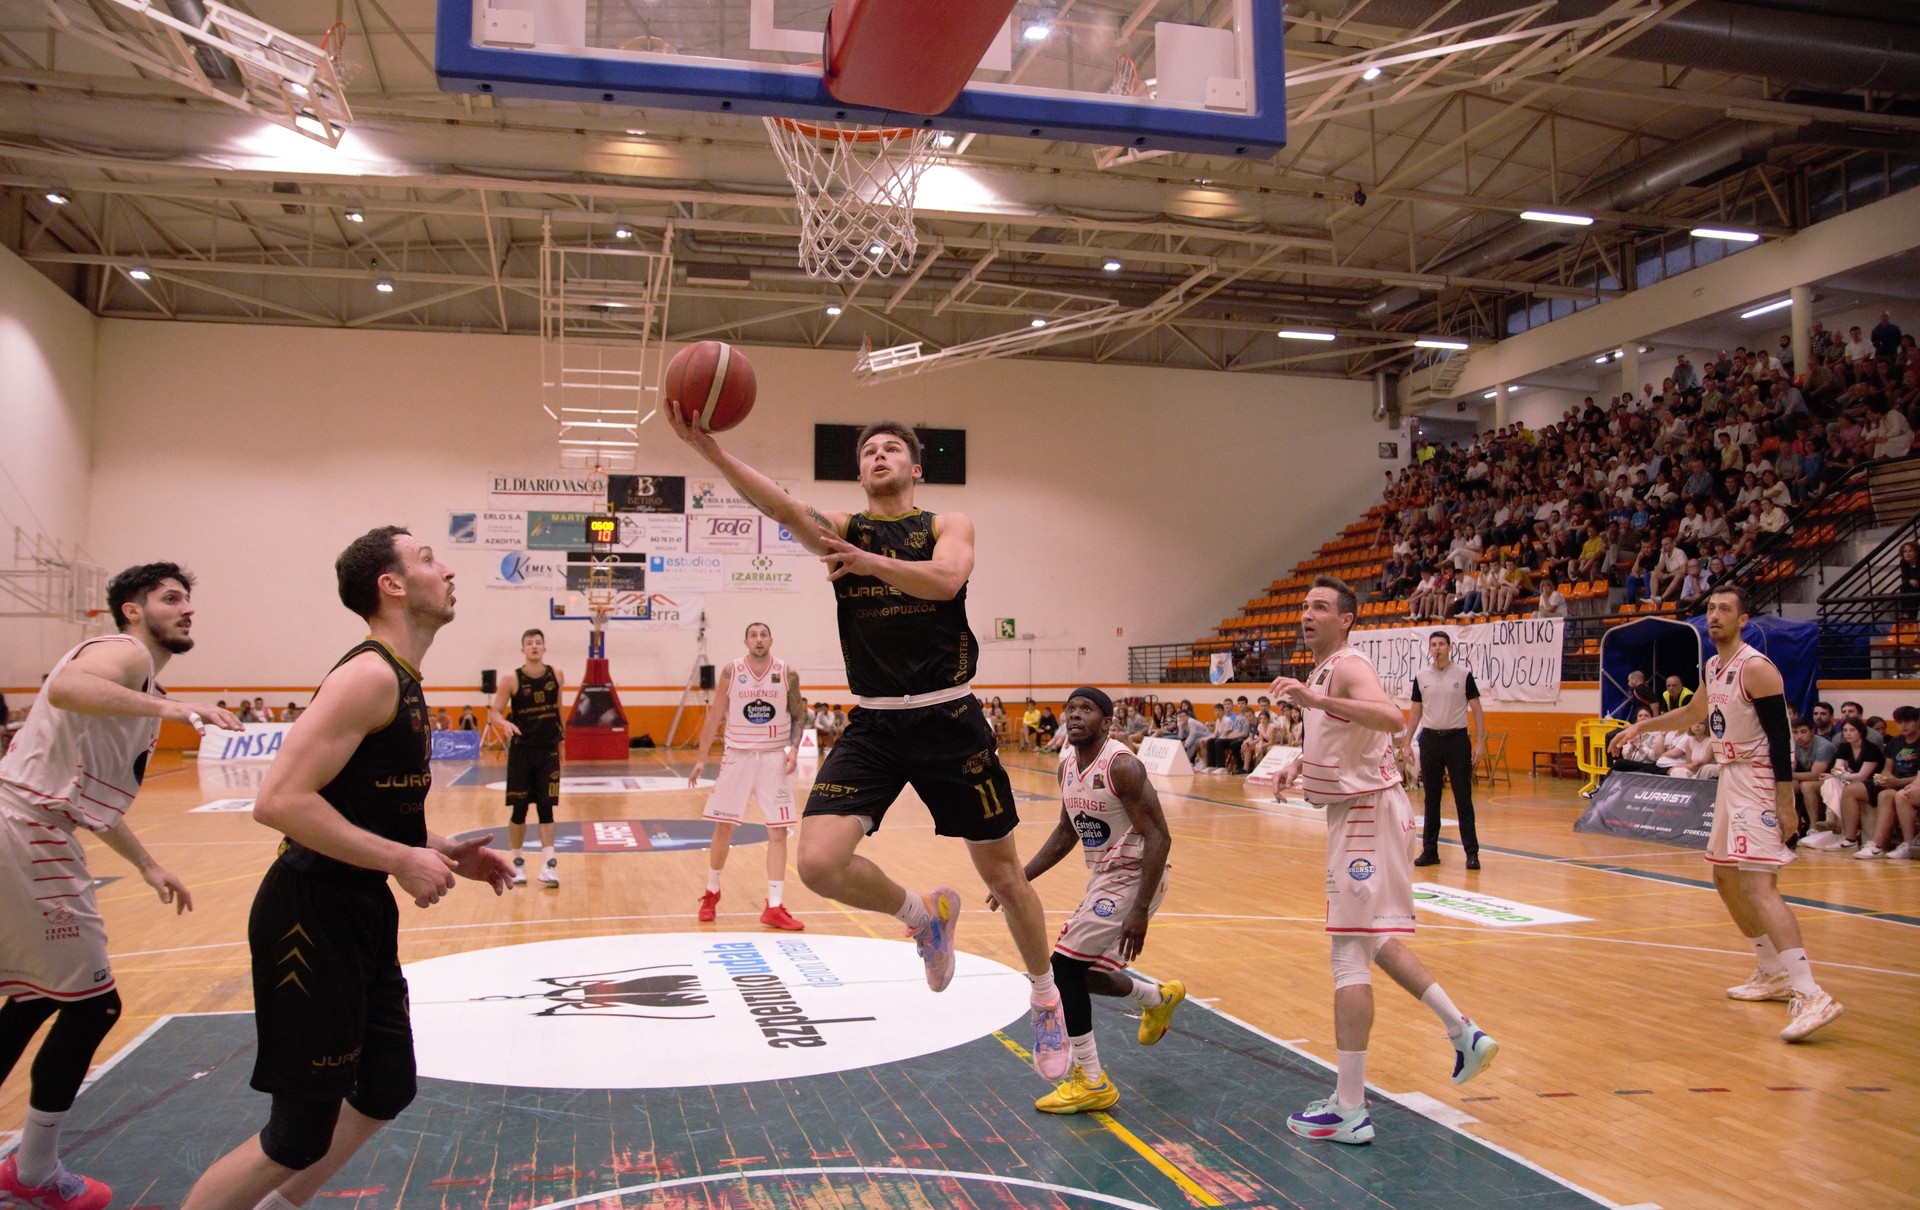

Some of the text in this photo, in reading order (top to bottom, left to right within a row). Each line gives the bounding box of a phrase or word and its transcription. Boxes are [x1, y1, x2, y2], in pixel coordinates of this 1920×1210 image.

[494, 478, 602, 492] EL DIARIO VASCO
[483, 513, 505, 521] ERLO
[597, 530, 612, 542] 10
[731, 573, 793, 582] IZARRAITZ
[1492, 620, 1555, 646] LORTUKO
[1490, 655, 1556, 689] DUGU!!
[767, 725, 777, 738] 11
[1722, 741, 1736, 760] 13
[974, 778, 1004, 820] 11
[1633, 791, 1692, 804] JUARISTI
[779, 806, 790, 821] 11
